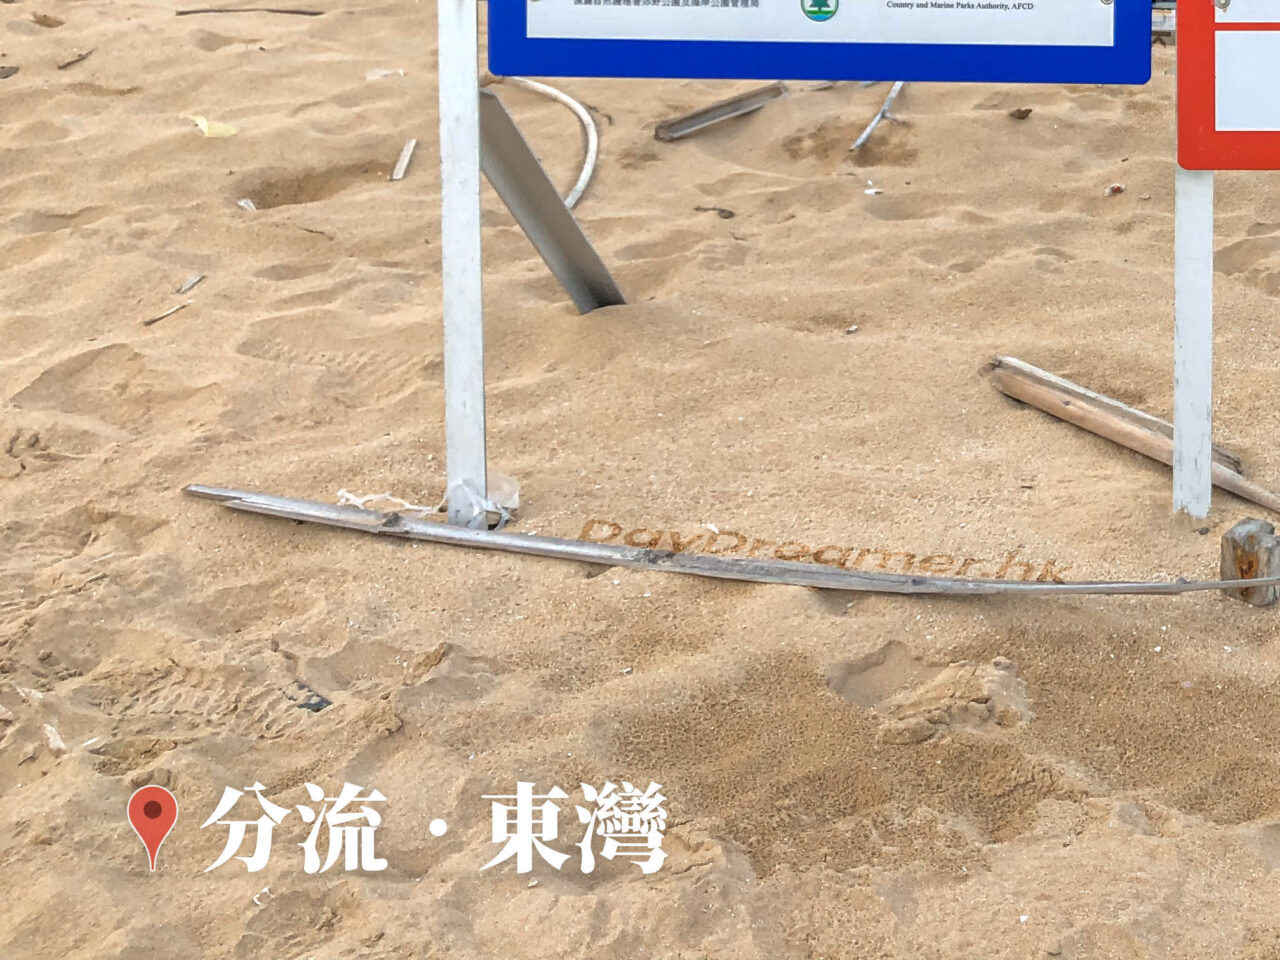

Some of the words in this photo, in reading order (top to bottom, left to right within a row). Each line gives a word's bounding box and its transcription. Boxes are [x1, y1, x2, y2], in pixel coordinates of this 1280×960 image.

[886, 0, 914, 10] Country
[929, 1, 954, 9] Marine
[955, 1, 975, 9] Parks
[975, 1, 1010, 11] Authority,
[1011, 2, 1034, 10] AFCD
